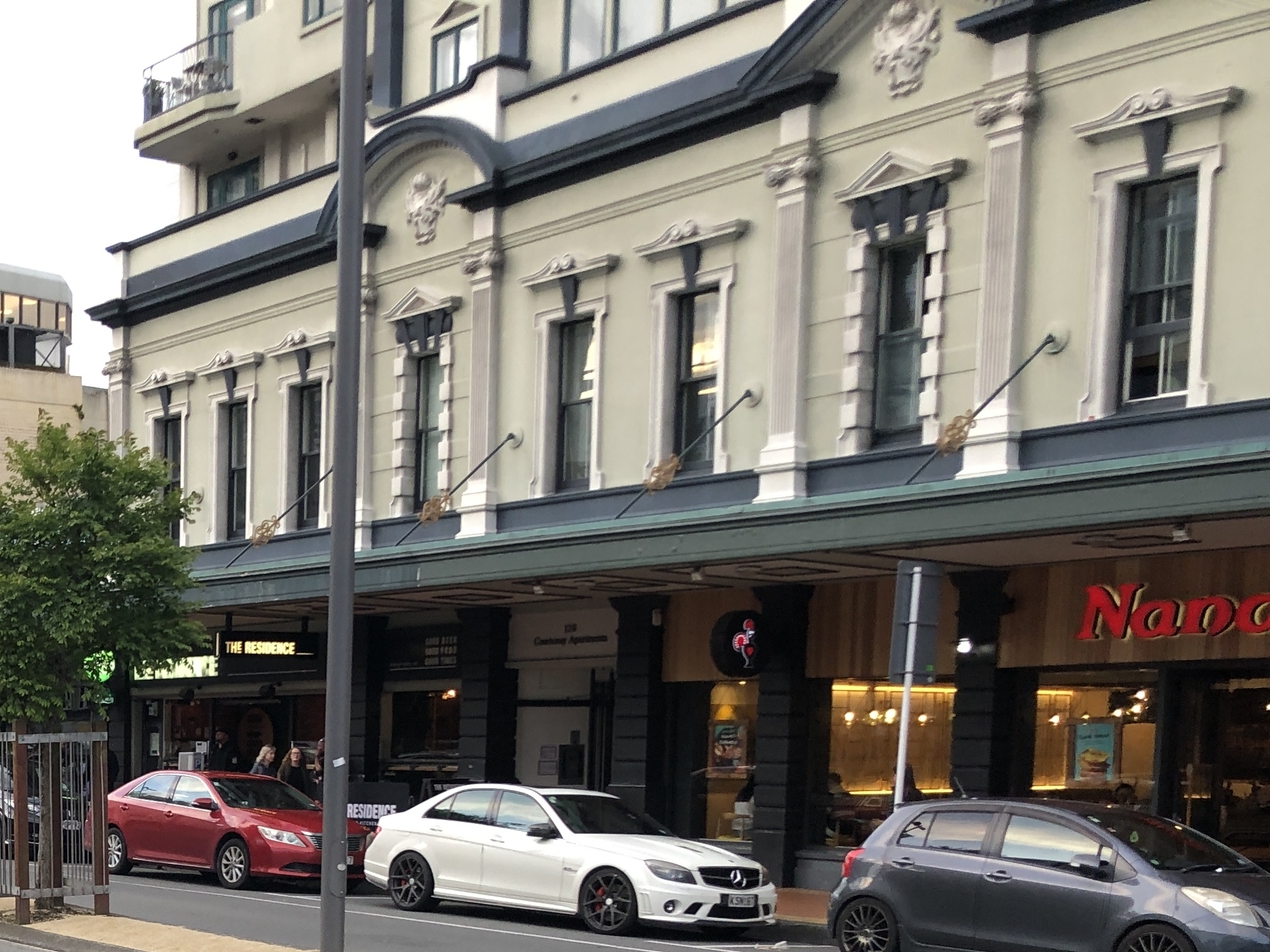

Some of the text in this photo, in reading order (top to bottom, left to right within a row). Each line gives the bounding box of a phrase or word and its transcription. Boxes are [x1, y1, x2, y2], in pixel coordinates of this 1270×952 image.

[225, 641, 296, 655] THE RESIDENCE
[347, 803, 397, 820] RESIDENCE
